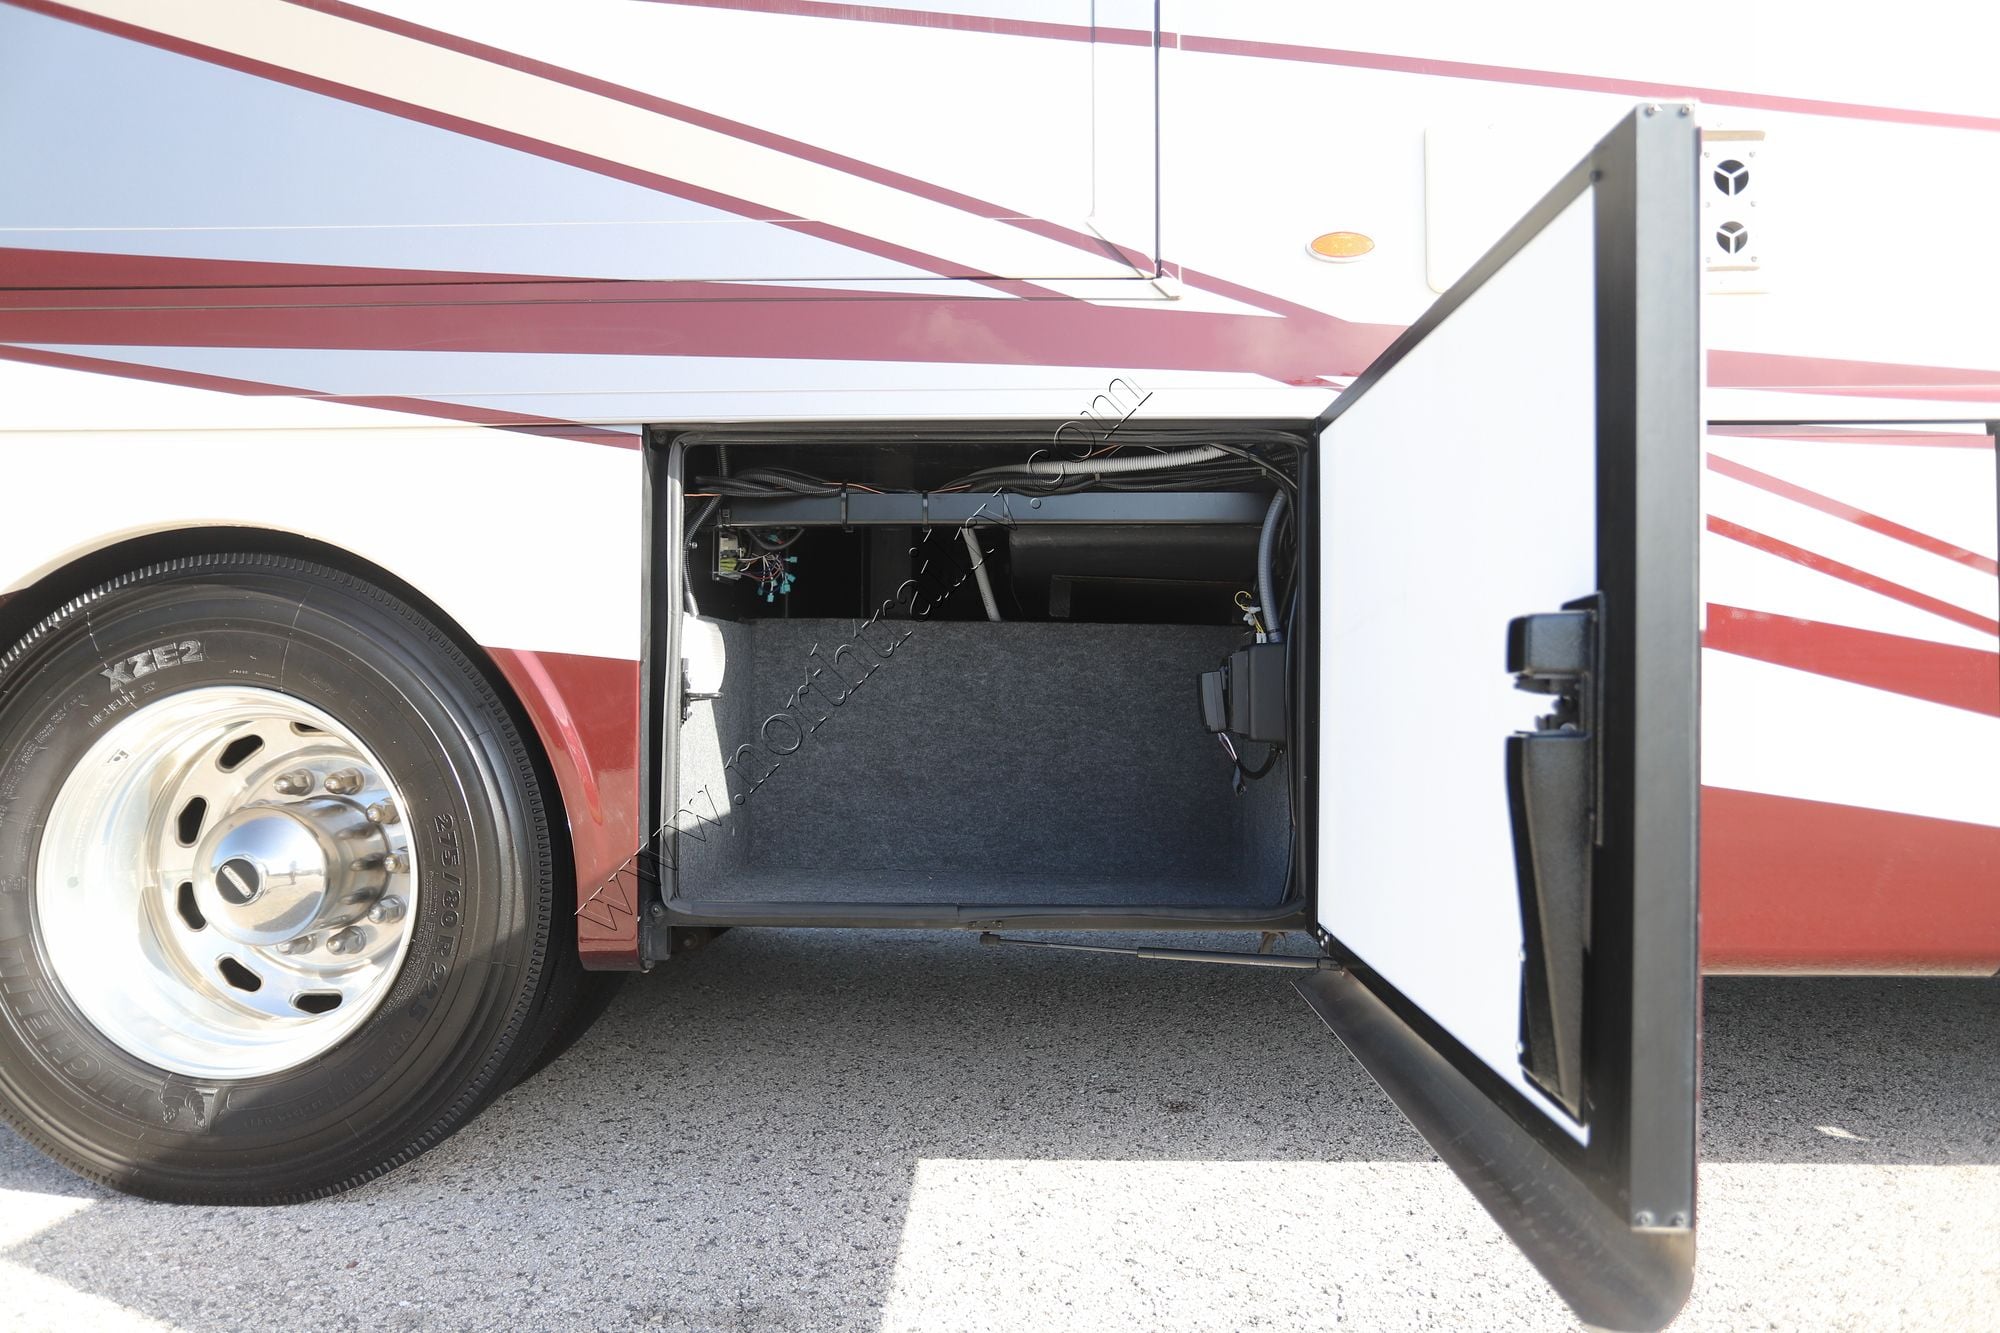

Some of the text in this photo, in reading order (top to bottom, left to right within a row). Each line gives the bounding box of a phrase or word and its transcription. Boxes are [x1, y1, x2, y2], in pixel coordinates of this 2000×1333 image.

[100, 640, 203, 692] XZE2
[433, 813, 461, 928] 275/80
[436, 935, 456, 957] R
